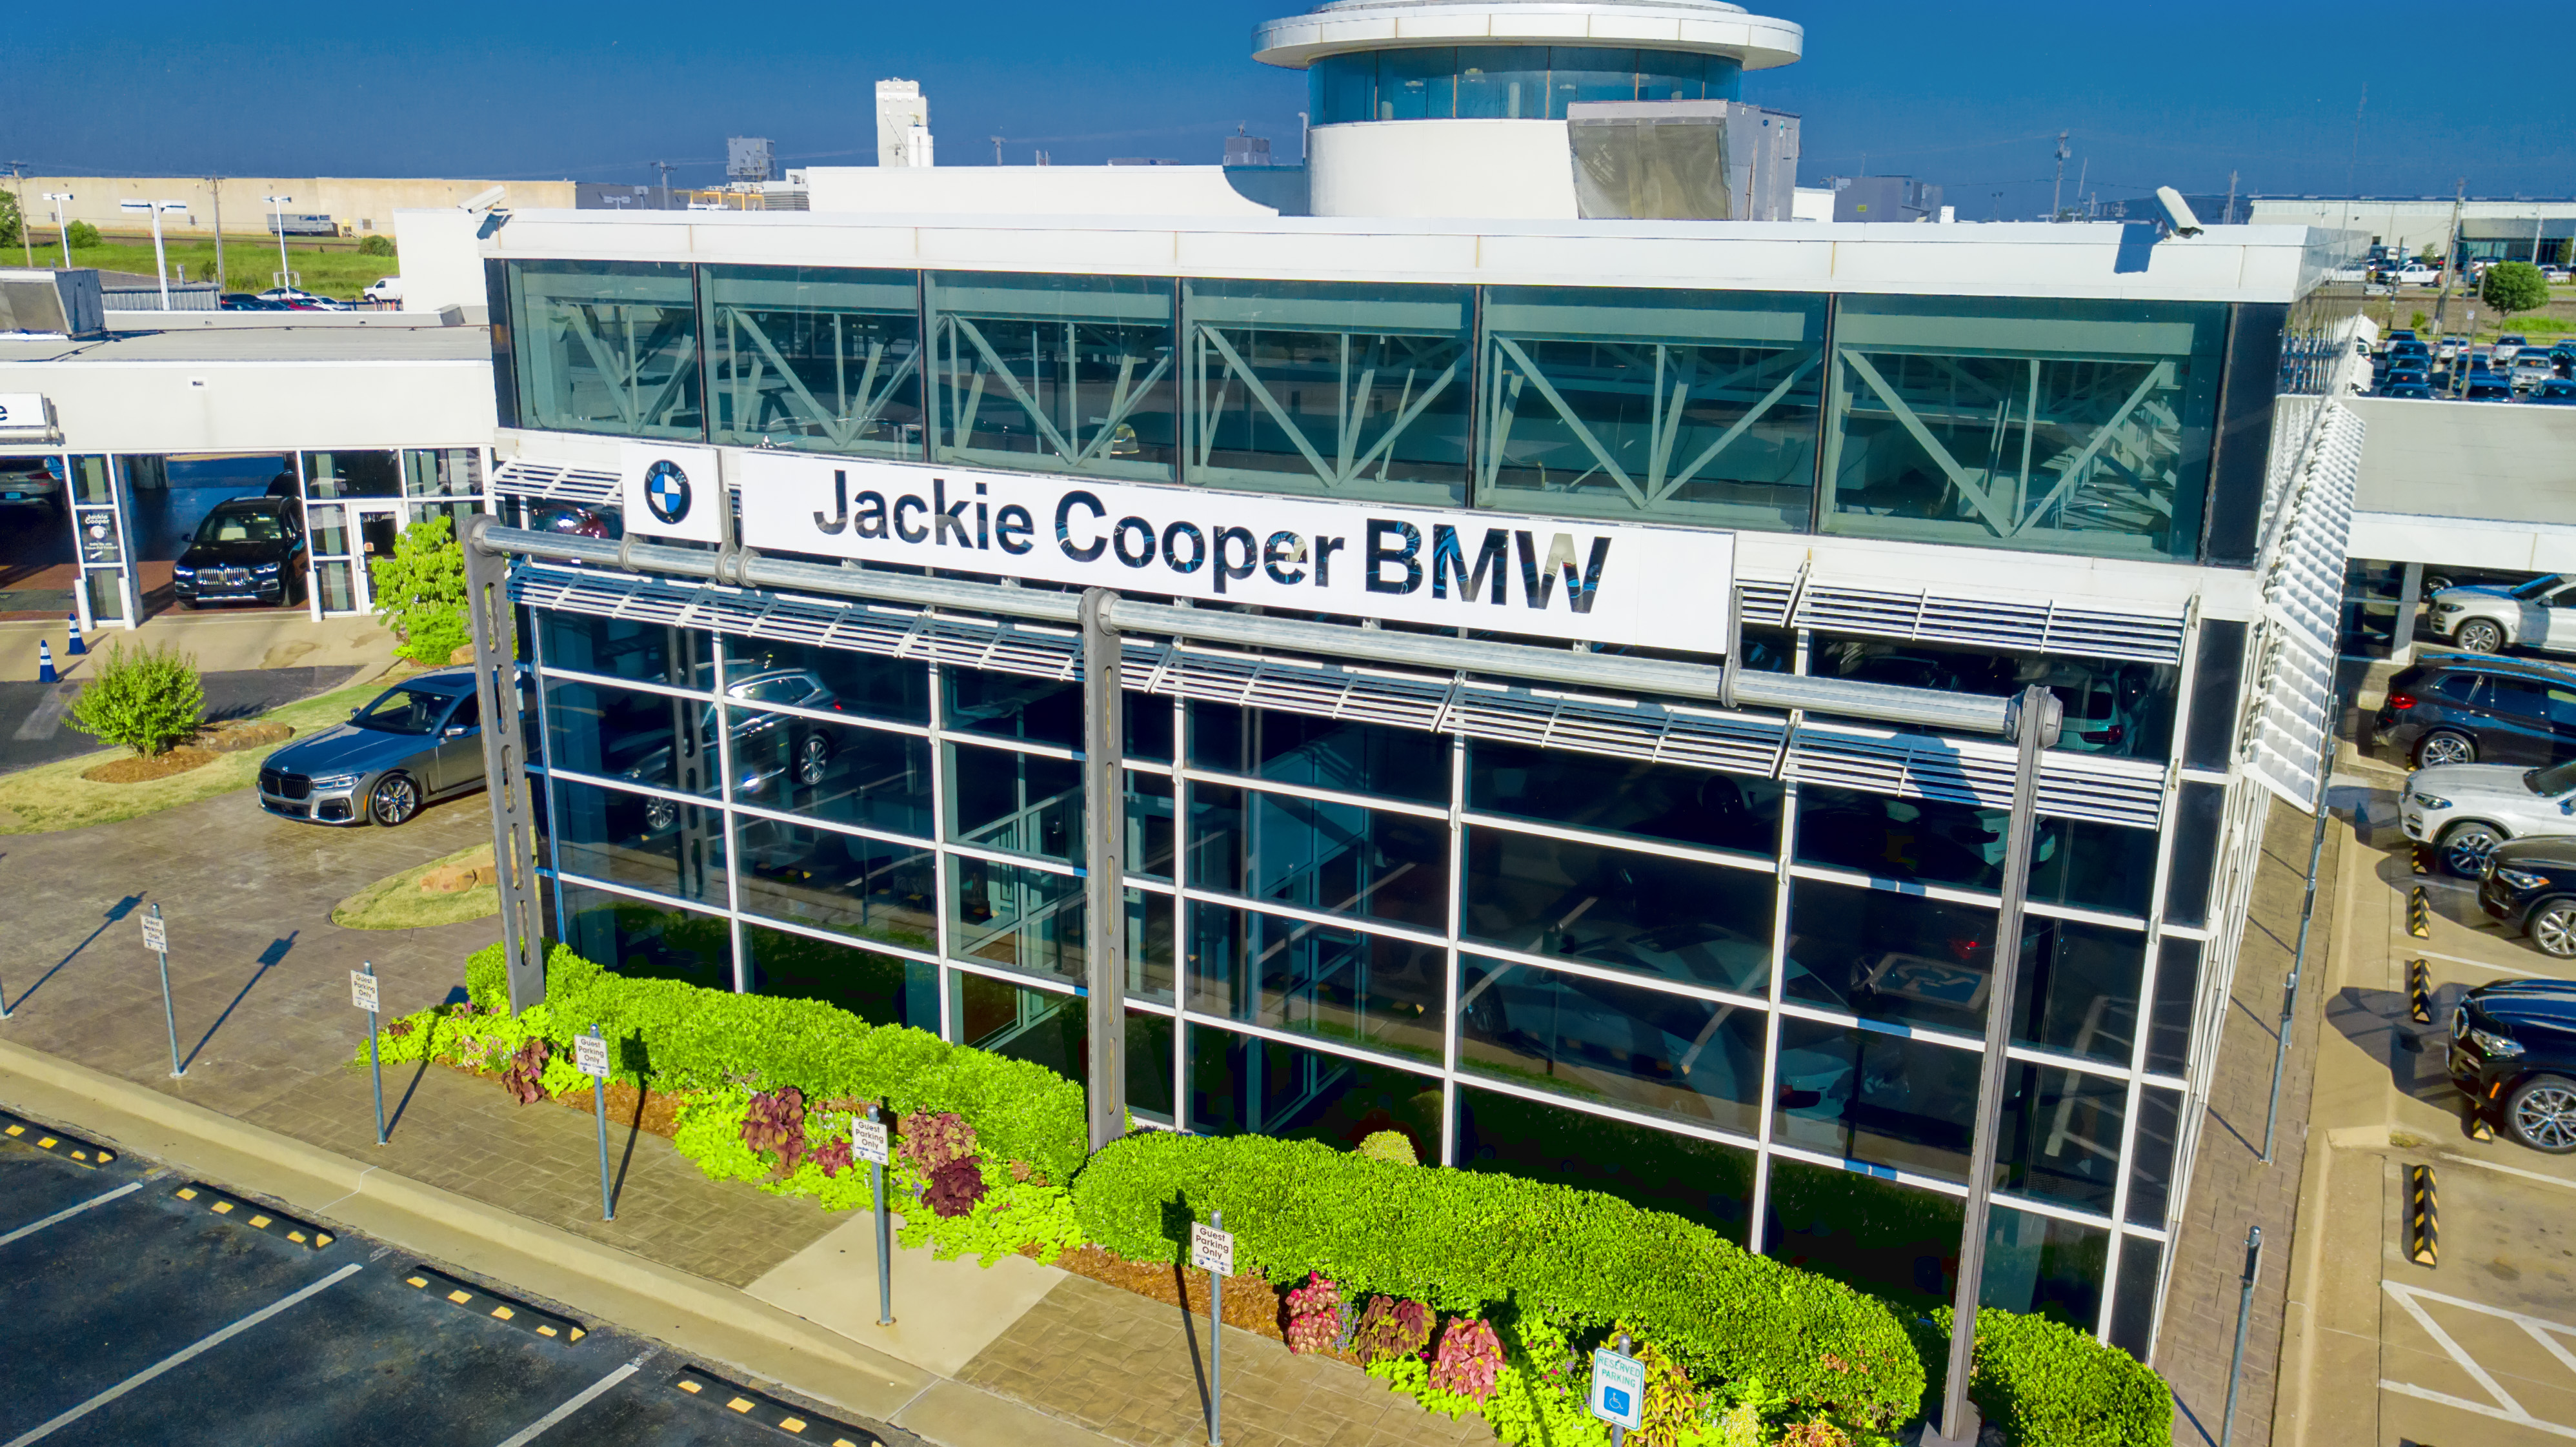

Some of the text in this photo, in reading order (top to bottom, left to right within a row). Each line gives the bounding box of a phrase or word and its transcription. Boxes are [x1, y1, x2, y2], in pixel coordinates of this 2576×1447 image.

[646, 462, 687, 484] BMW
[813, 469, 1613, 614] Jackie Cooper BMW
[356, 974, 372, 984] Guest
[354, 980, 376, 994] Parking
[359, 989, 371, 999] Only
[581, 1038, 600, 1048] Guest
[579, 1045, 605, 1058] Parking
[584, 1054, 599, 1064] Only
[858, 1121, 880, 1133] Guest
[856, 1129, 884, 1144] Parking
[862, 1138, 878, 1149] Only
[1200, 1227, 1225, 1242] Guest
[1196, 1234, 1229, 1254] Parking
[1202, 1246, 1222, 1260] Only
[1598, 1355, 1640, 1377] RESERVED
[1602, 1368, 1636, 1388] PARKING
